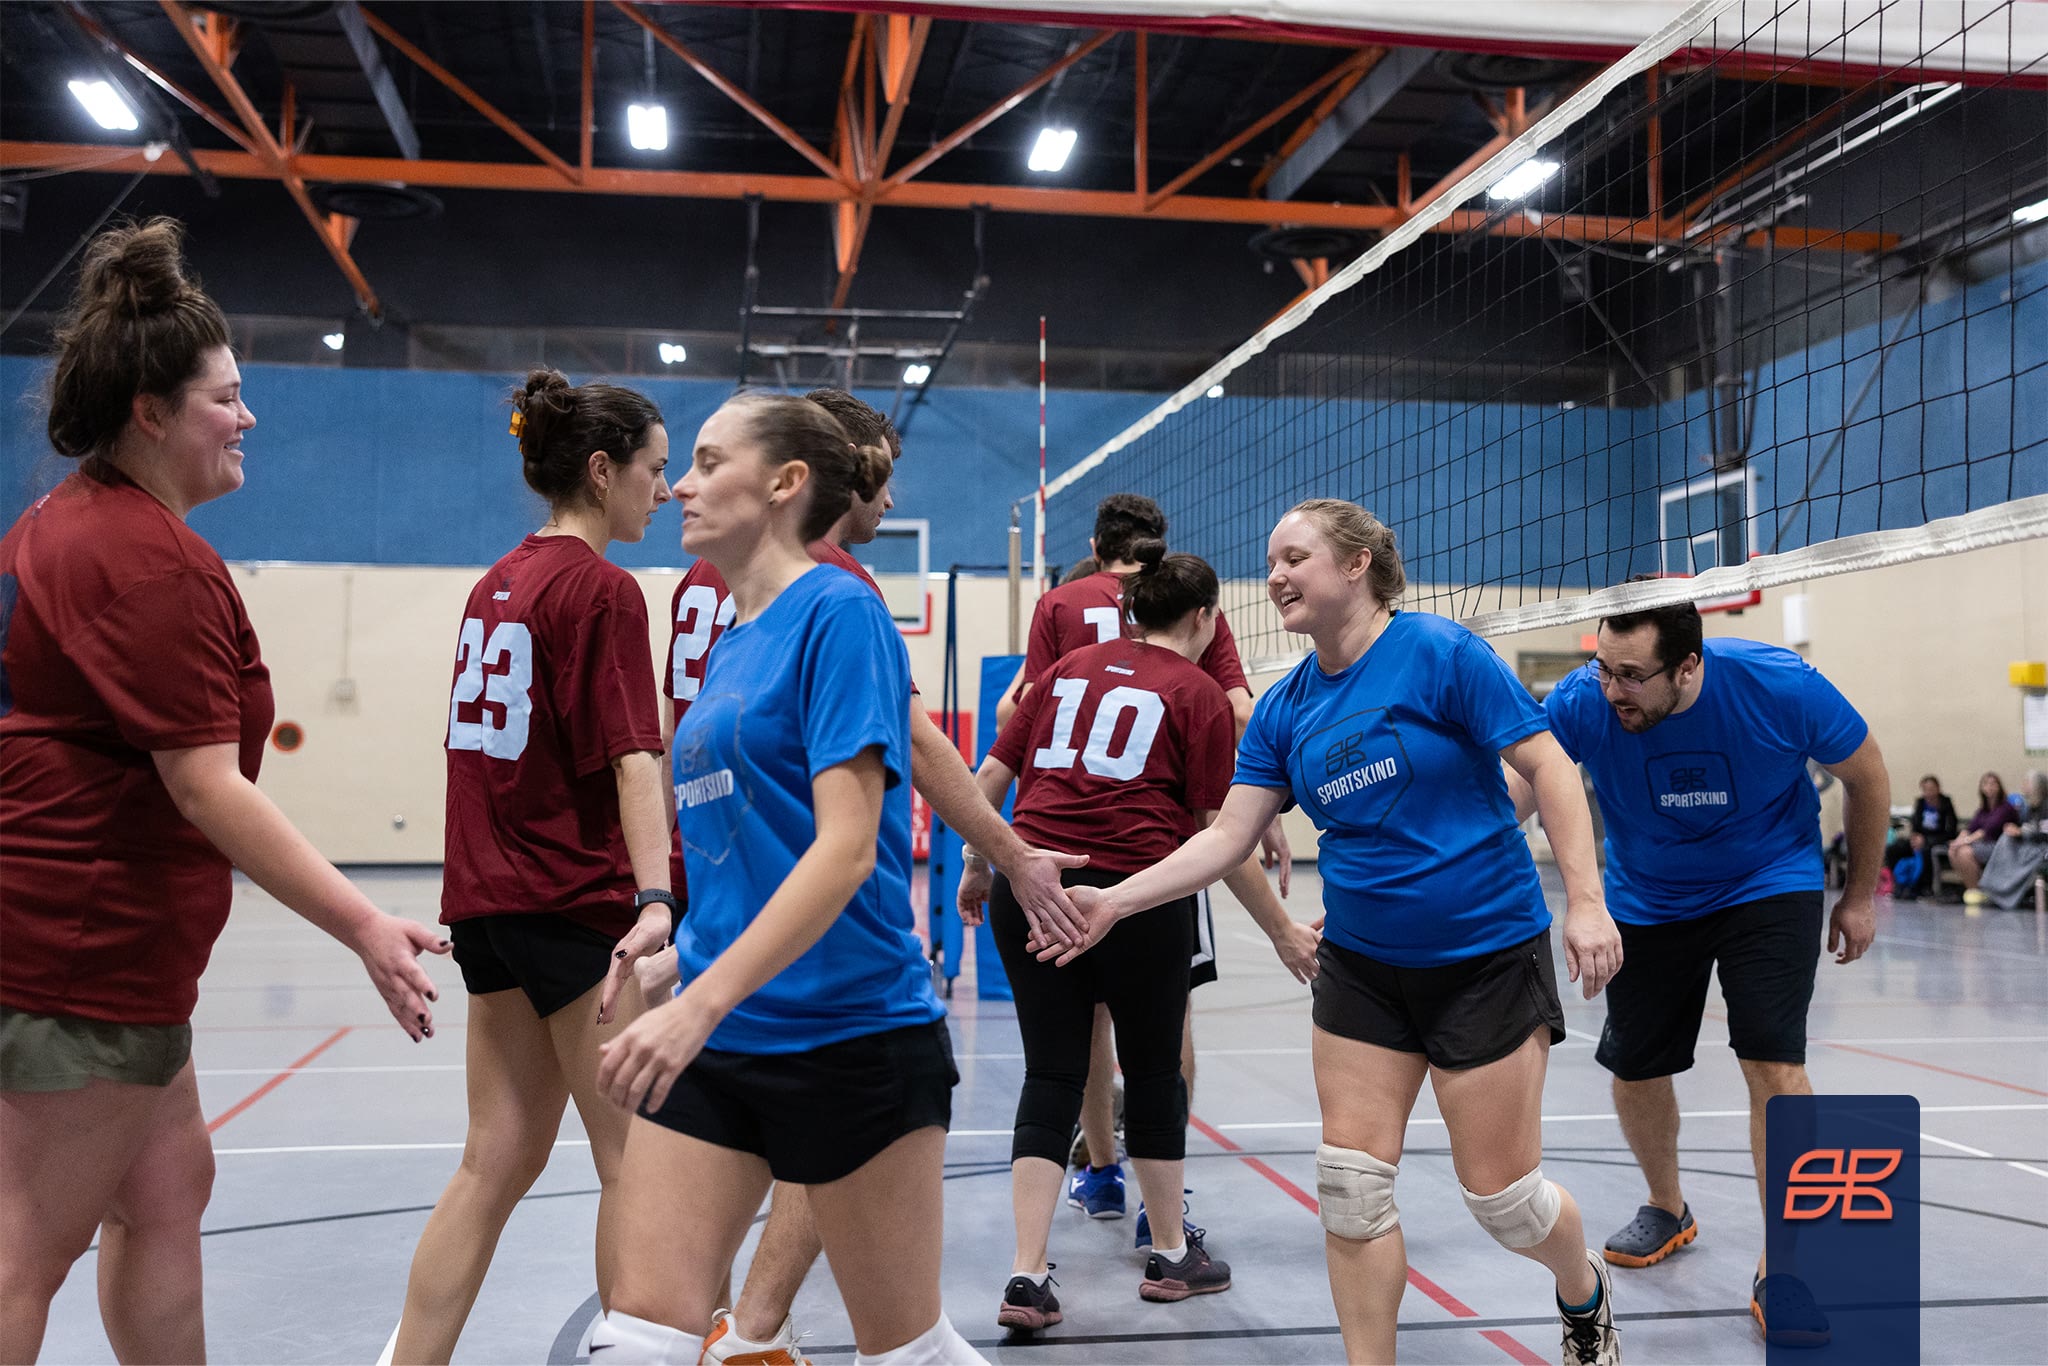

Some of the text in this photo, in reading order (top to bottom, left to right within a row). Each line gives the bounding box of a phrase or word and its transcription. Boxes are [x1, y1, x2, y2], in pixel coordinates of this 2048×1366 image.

[673, 585, 737, 701] 2
[1083, 606, 1138, 644] 1
[448, 617, 533, 760] 23
[1033, 677, 1166, 781] 10
[1317, 757, 1397, 806] SPORTSKIND
[1660, 791, 1728, 808] SPORTSKIND
